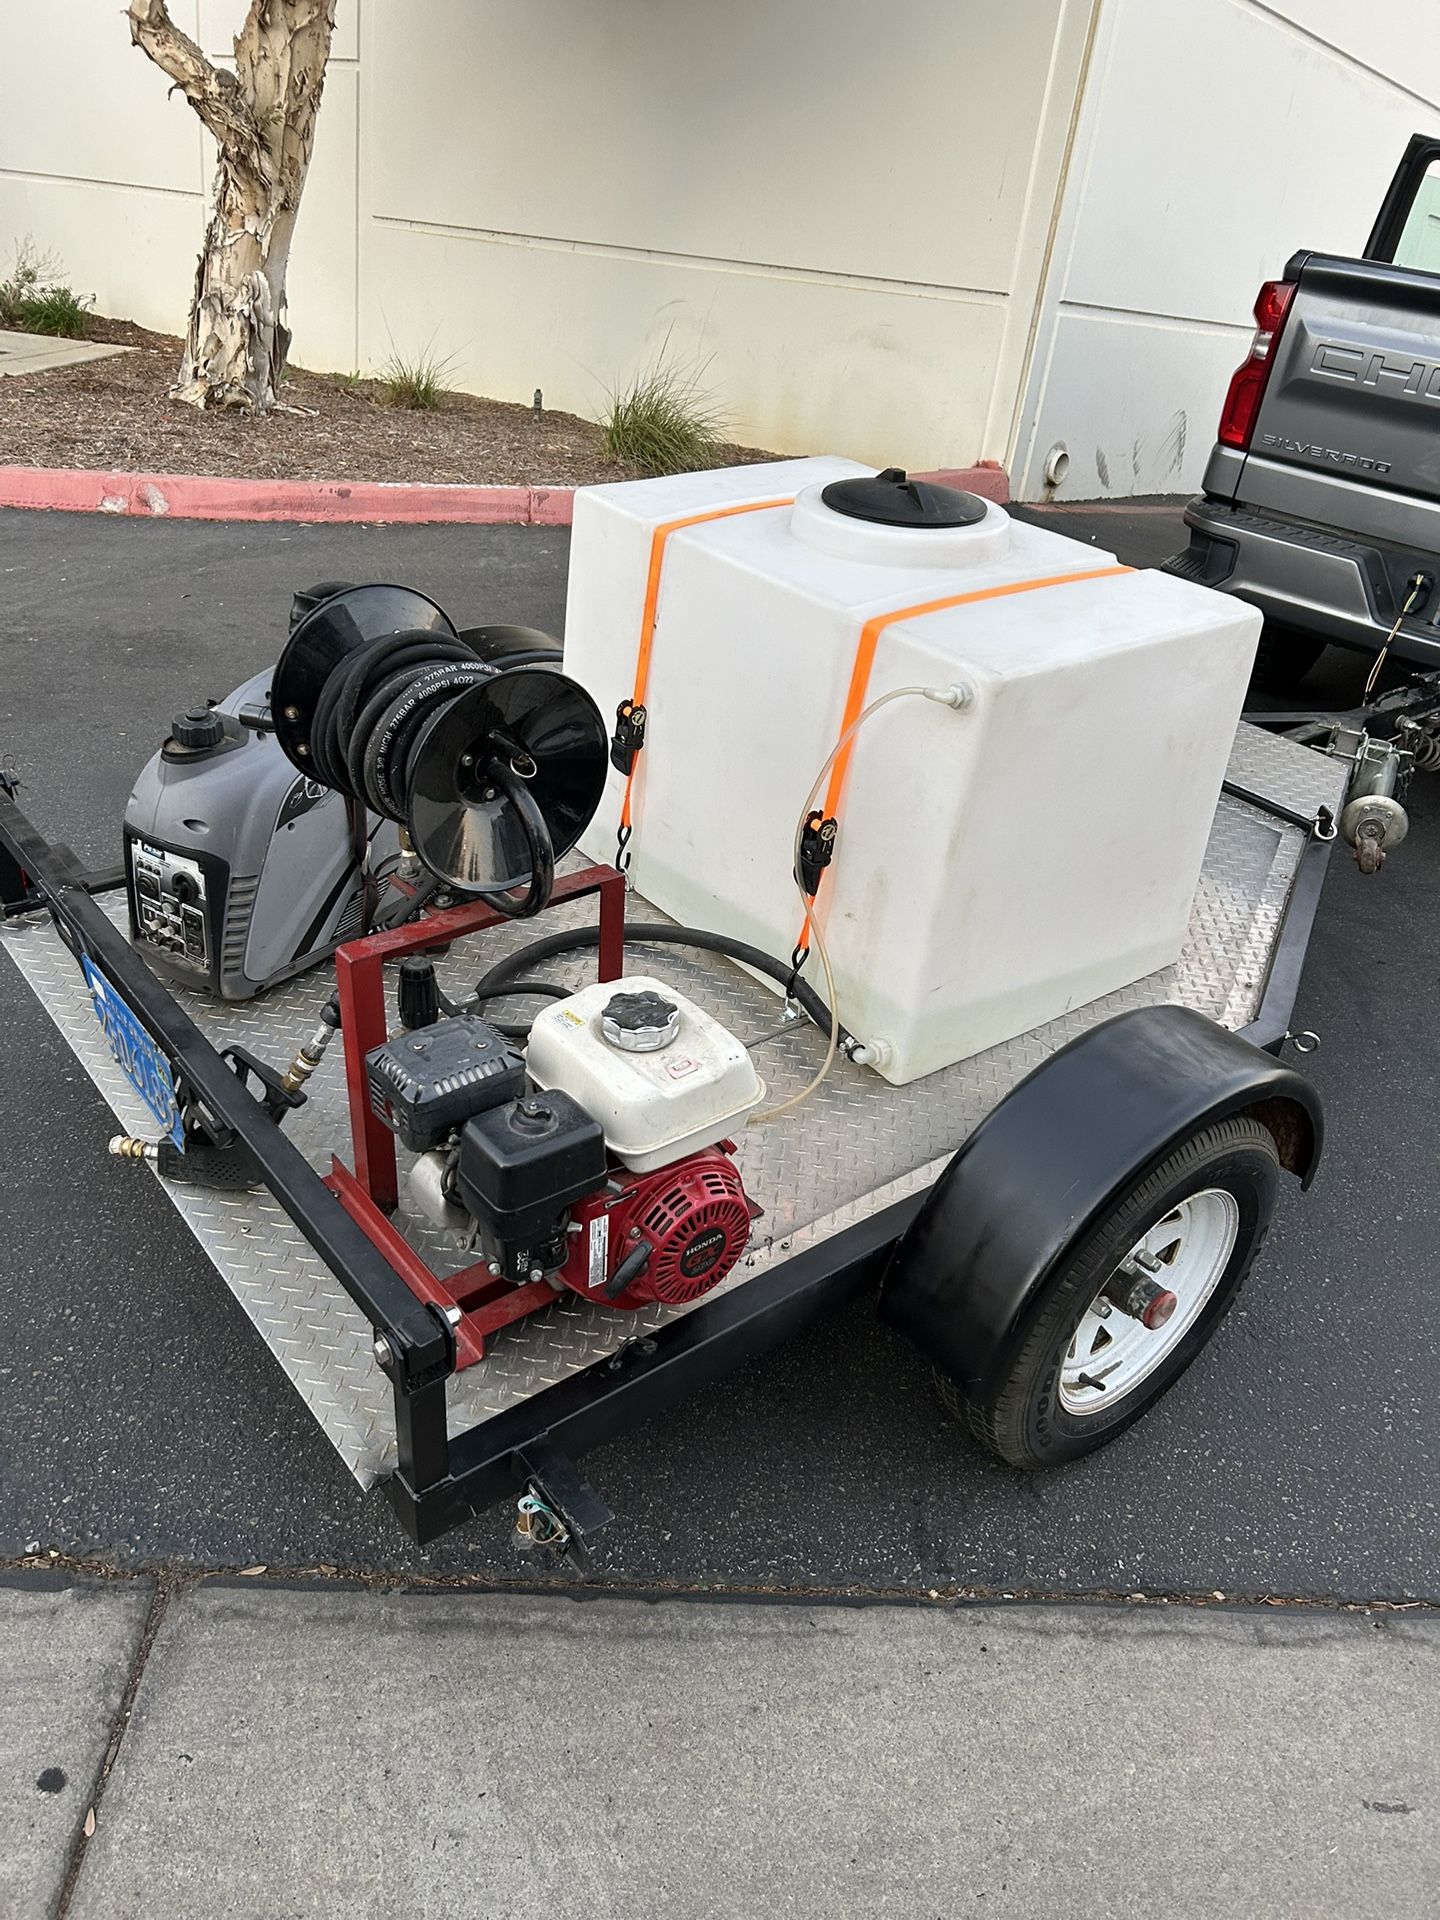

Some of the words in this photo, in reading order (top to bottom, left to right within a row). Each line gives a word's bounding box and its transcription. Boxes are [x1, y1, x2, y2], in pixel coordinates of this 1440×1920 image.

[1261, 433, 1392, 474] SILVERADO
[379, 731, 393, 753] INCH
[389, 698, 417, 730] 275BAR
[417, 679, 450, 699] 4000PSI
[685, 1234, 723, 1256] HONDA
